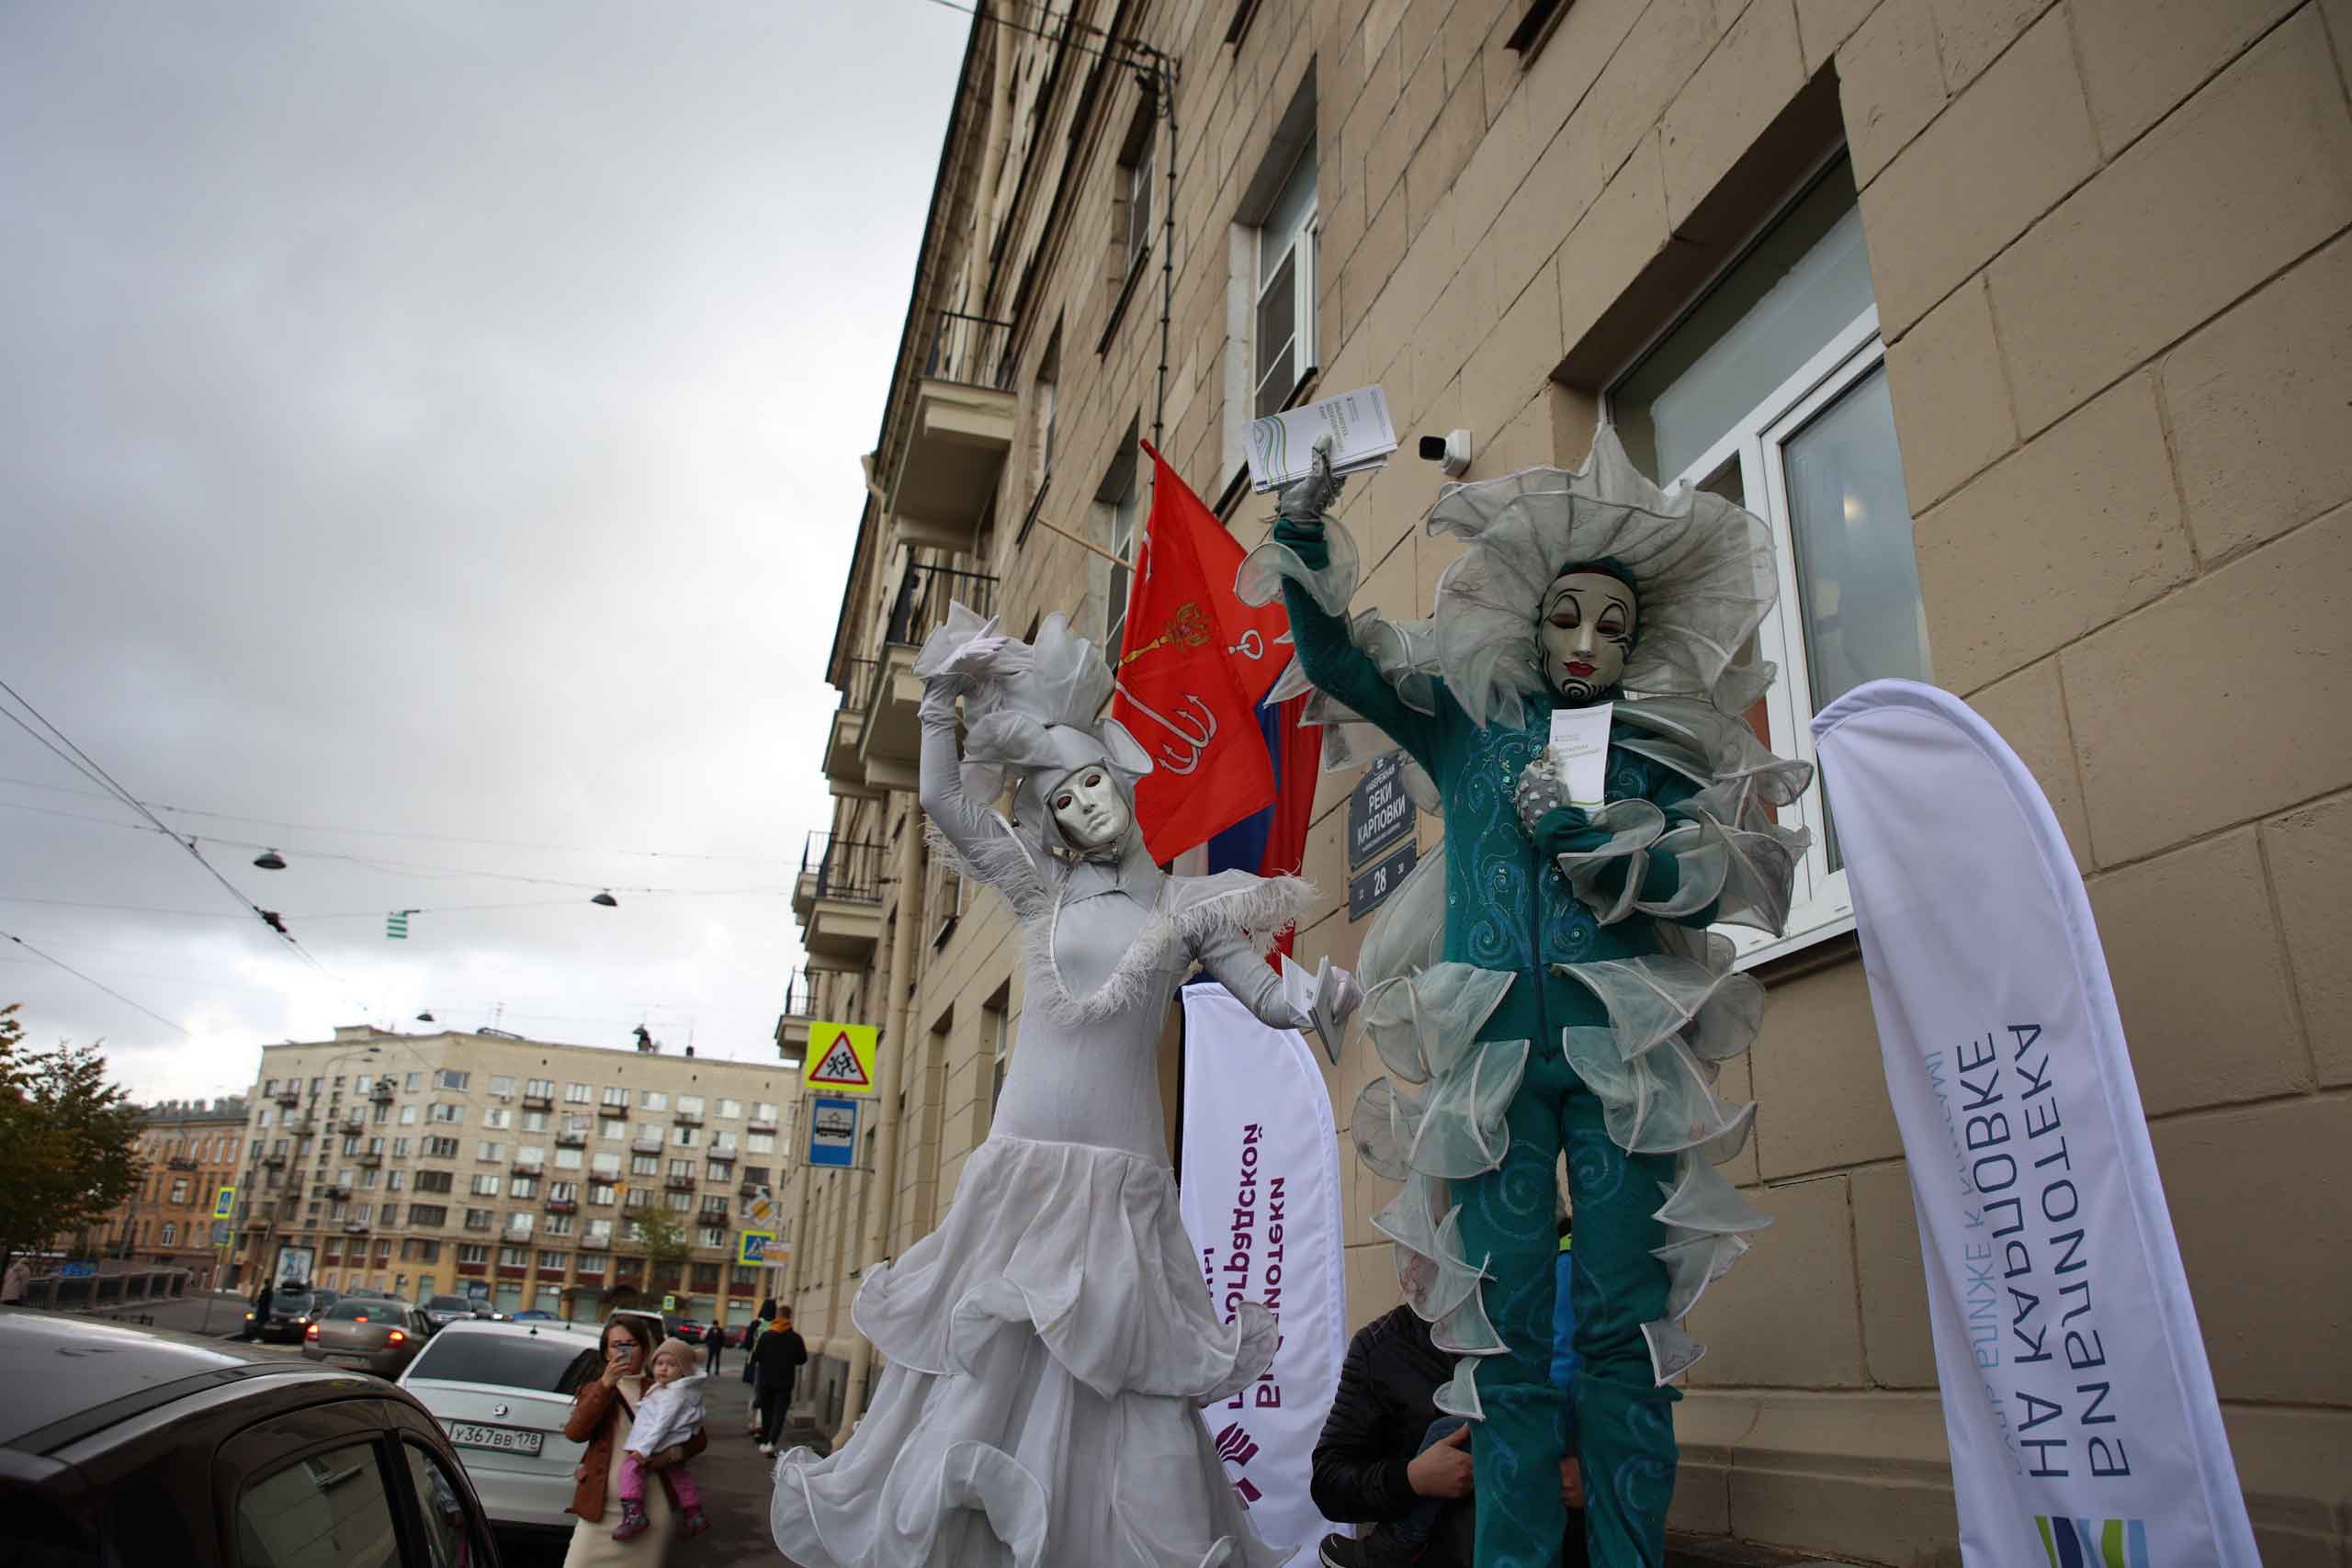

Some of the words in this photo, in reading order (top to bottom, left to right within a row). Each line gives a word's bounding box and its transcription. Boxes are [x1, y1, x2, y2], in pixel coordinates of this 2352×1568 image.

[1368, 781, 1393, 815] РЕКИ
[1357, 793, 1406, 846] КАРПОВКИ
[1374, 866, 1386, 897] 28
